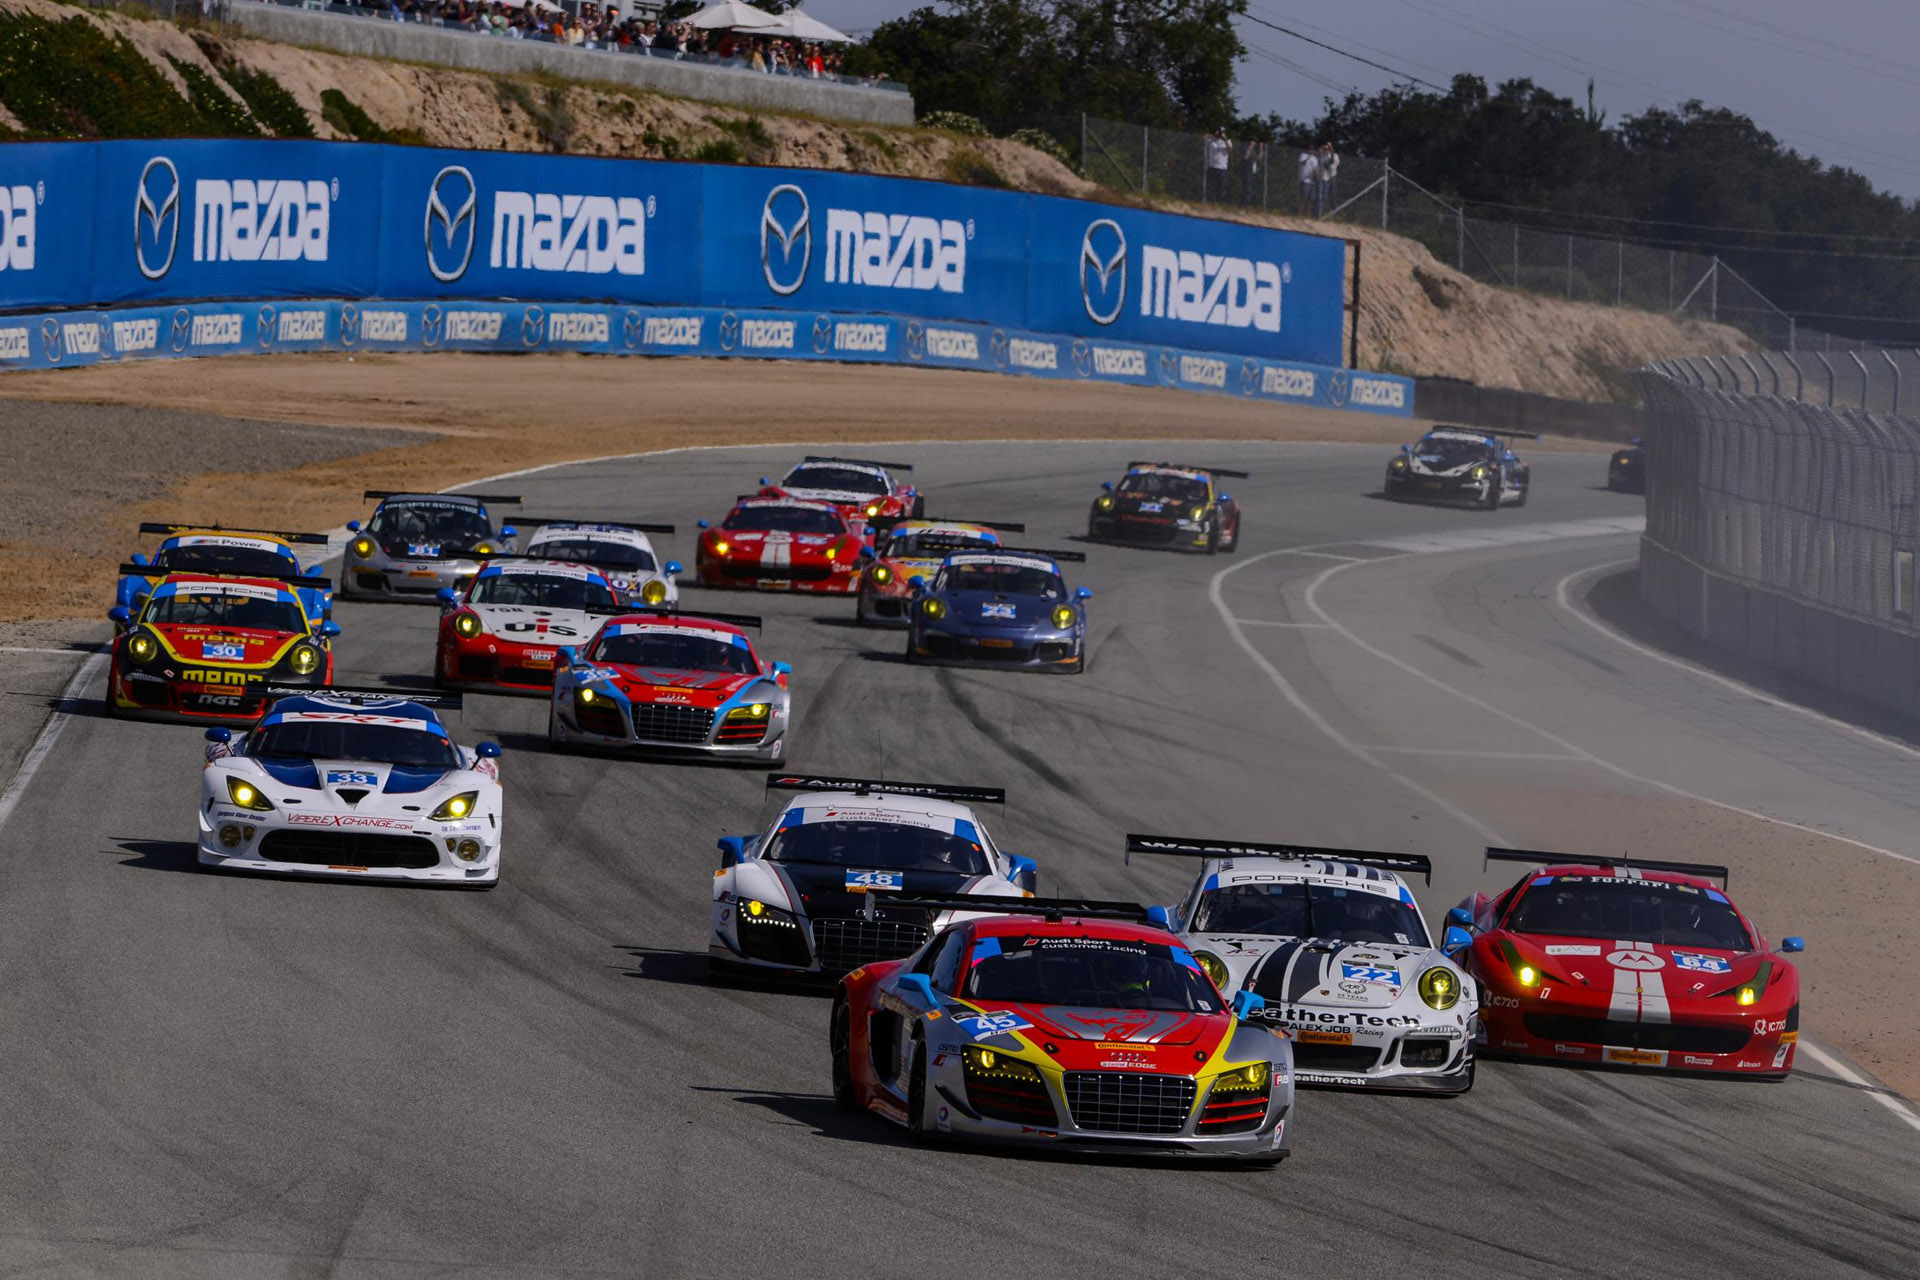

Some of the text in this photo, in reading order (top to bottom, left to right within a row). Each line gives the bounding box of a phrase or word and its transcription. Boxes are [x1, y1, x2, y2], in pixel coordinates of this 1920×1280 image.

[193, 179, 329, 261] mazda
[490, 191, 645, 275] mazda
[825, 208, 966, 293] mazda
[1141, 244, 1282, 333] mazda
[221, 540, 262, 548] Power
[176, 585, 276, 598] PORSCHE
[212, 646, 237, 657] 30
[292, 712, 420, 724] SRT
[336, 773, 367, 784] 33
[896, 820, 930, 828] racing
[855, 872, 893, 885] 48
[1232, 875, 1387, 894] PORSCHE
[1590, 876, 1670, 890] Ferrari
[1074, 938, 1111, 946] Sport
[1107, 945, 1146, 955] racing
[1682, 957, 1721, 971] 64
[1350, 966, 1394, 984] 22
[976, 1016, 1017, 1032] 45
[1247, 1007, 1420, 1028] eatherTech
[1289, 1023, 1385, 1039] ALEX JOB Racing
[1299, 1031, 1342, 1042] Continental
[1127, 1062, 1157, 1070] EDGE
[1294, 1075, 1367, 1086] eatherTech
